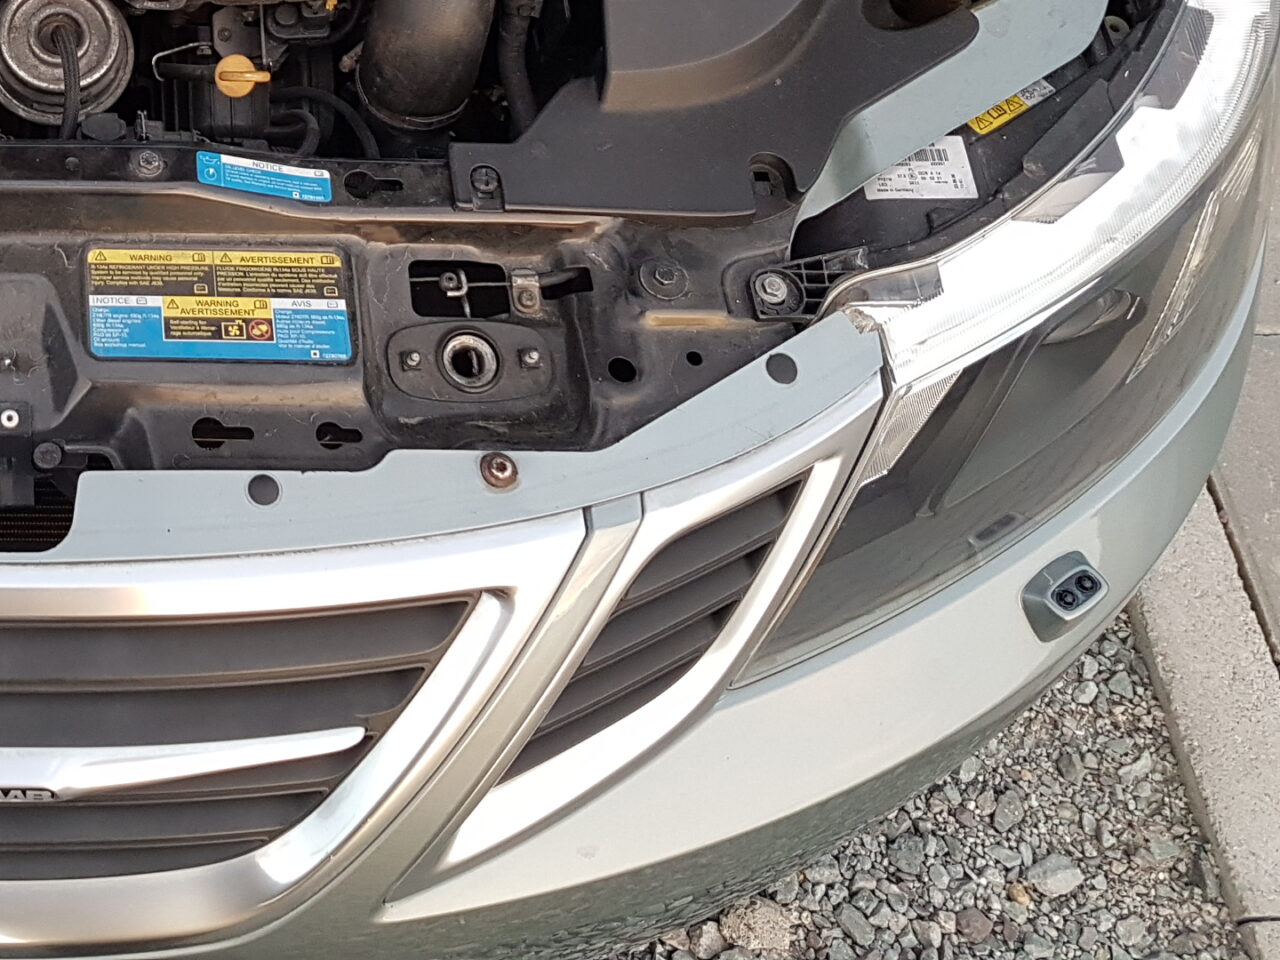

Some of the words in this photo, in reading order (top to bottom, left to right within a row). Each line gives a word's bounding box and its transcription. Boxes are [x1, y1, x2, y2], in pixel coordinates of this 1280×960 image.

[252, 161, 284, 172] NOTICE
[130, 254, 173, 262] WARNING
[240, 255, 314, 264] AVERTISSEMENT
[180, 308, 255, 316] AVERTISSEMENT
